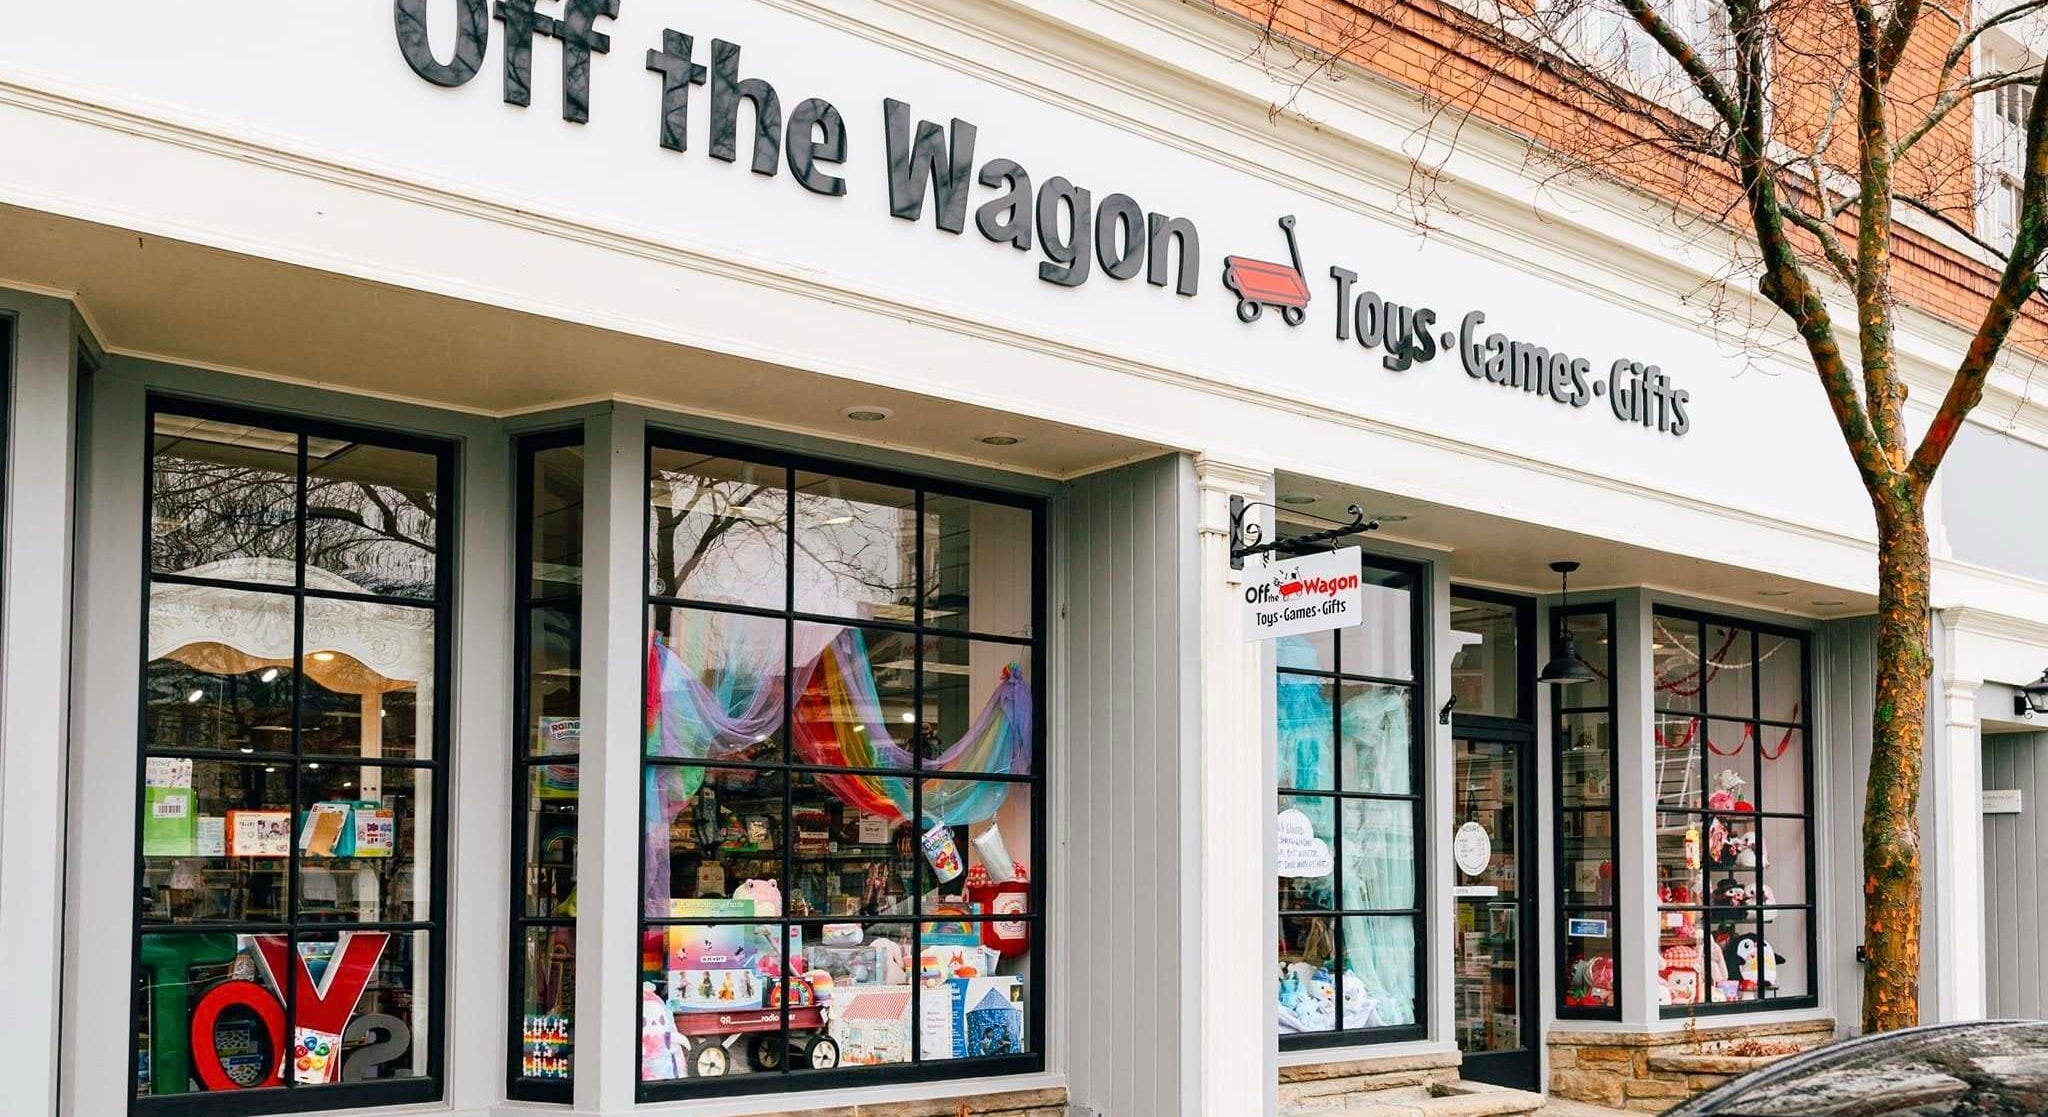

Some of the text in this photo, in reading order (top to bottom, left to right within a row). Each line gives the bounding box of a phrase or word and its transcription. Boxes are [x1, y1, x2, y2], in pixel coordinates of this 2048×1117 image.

[394, 0, 1200, 297] Off the Wagon
[1330, 265, 1690, 436] Toys Games Gifts
[1245, 574, 1358, 604] Off the Wagon
[1256, 599, 1346, 626] Toys Games Gifts
